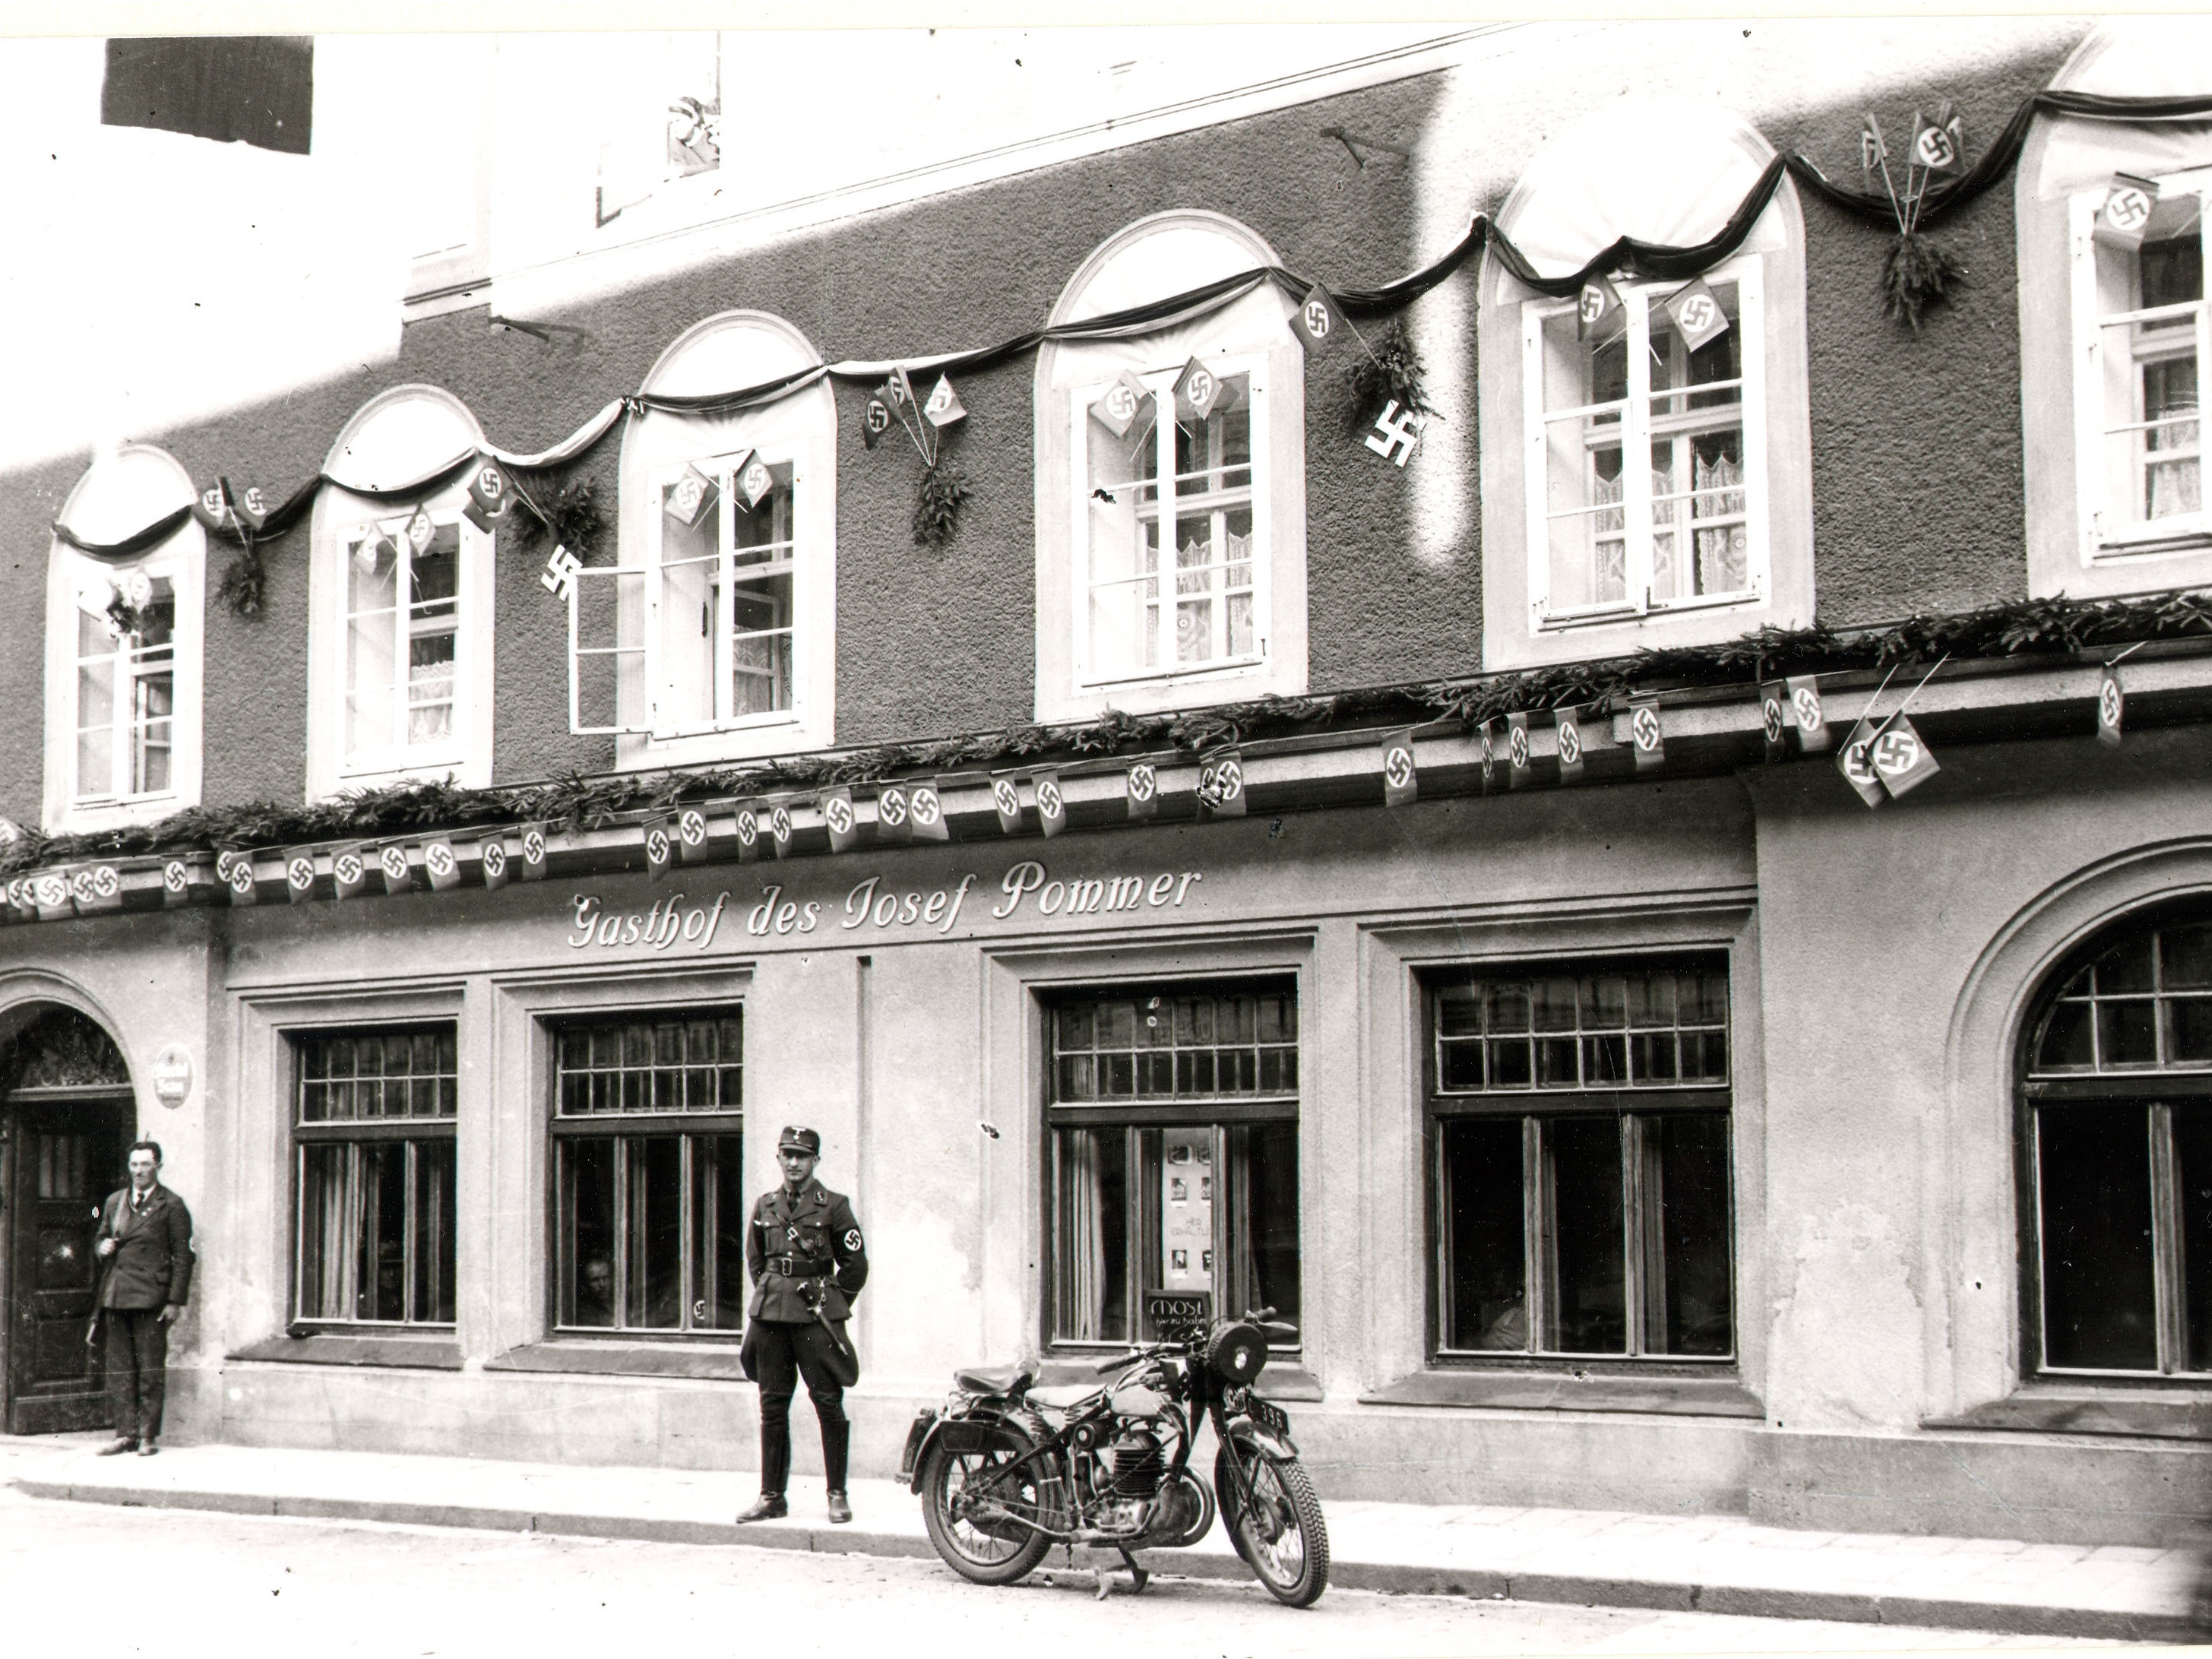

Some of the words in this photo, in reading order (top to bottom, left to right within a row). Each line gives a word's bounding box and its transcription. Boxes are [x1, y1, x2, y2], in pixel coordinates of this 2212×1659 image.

[568, 891, 731, 950] Gasthof
[748, 885, 821, 935] des
[842, 874, 977, 934] Josef
[992, 860, 1203, 919] Pommer
